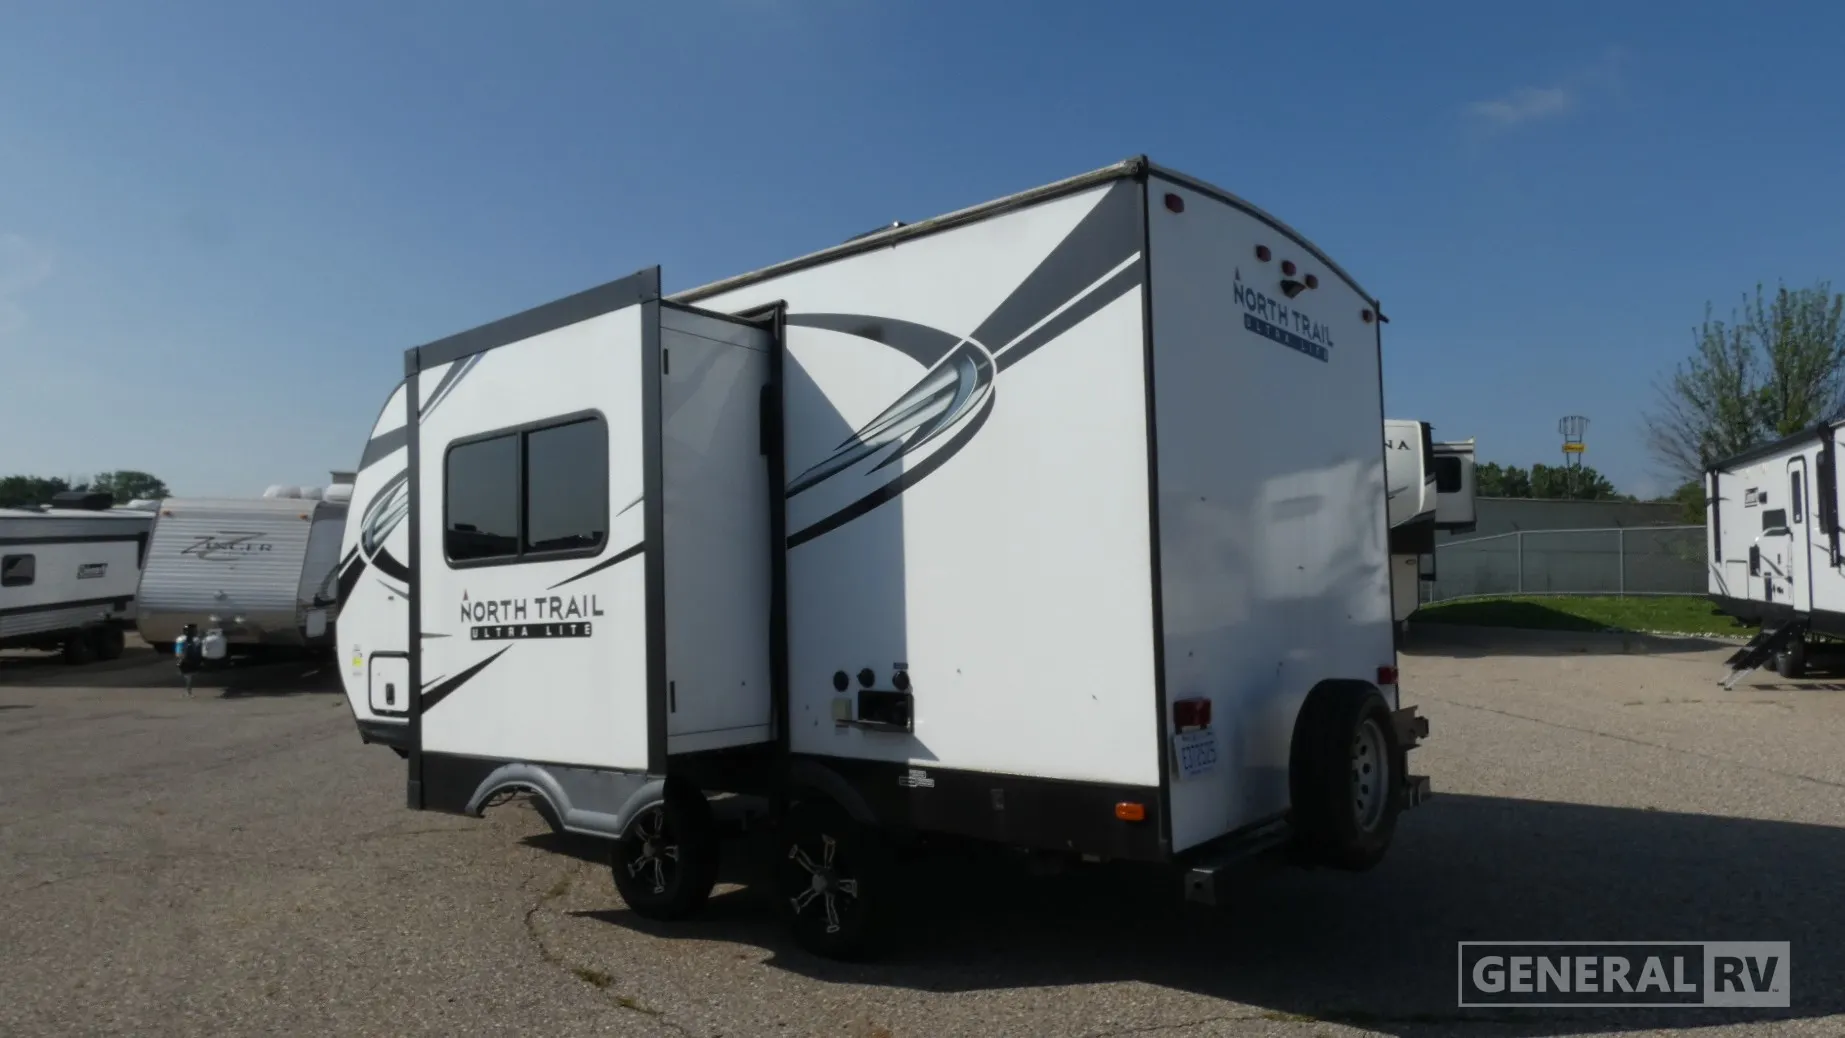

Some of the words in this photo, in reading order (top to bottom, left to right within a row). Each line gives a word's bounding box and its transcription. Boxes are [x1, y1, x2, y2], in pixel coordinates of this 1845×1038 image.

[1233, 280, 1288, 327] NORTH
[1292, 309, 1334, 347] TRAIL
[461, 599, 527, 623] NORTH
[535, 594, 604, 620] TRAIL
[472, 626, 528, 639] ULTRA
[546, 623, 591, 636] LITE
